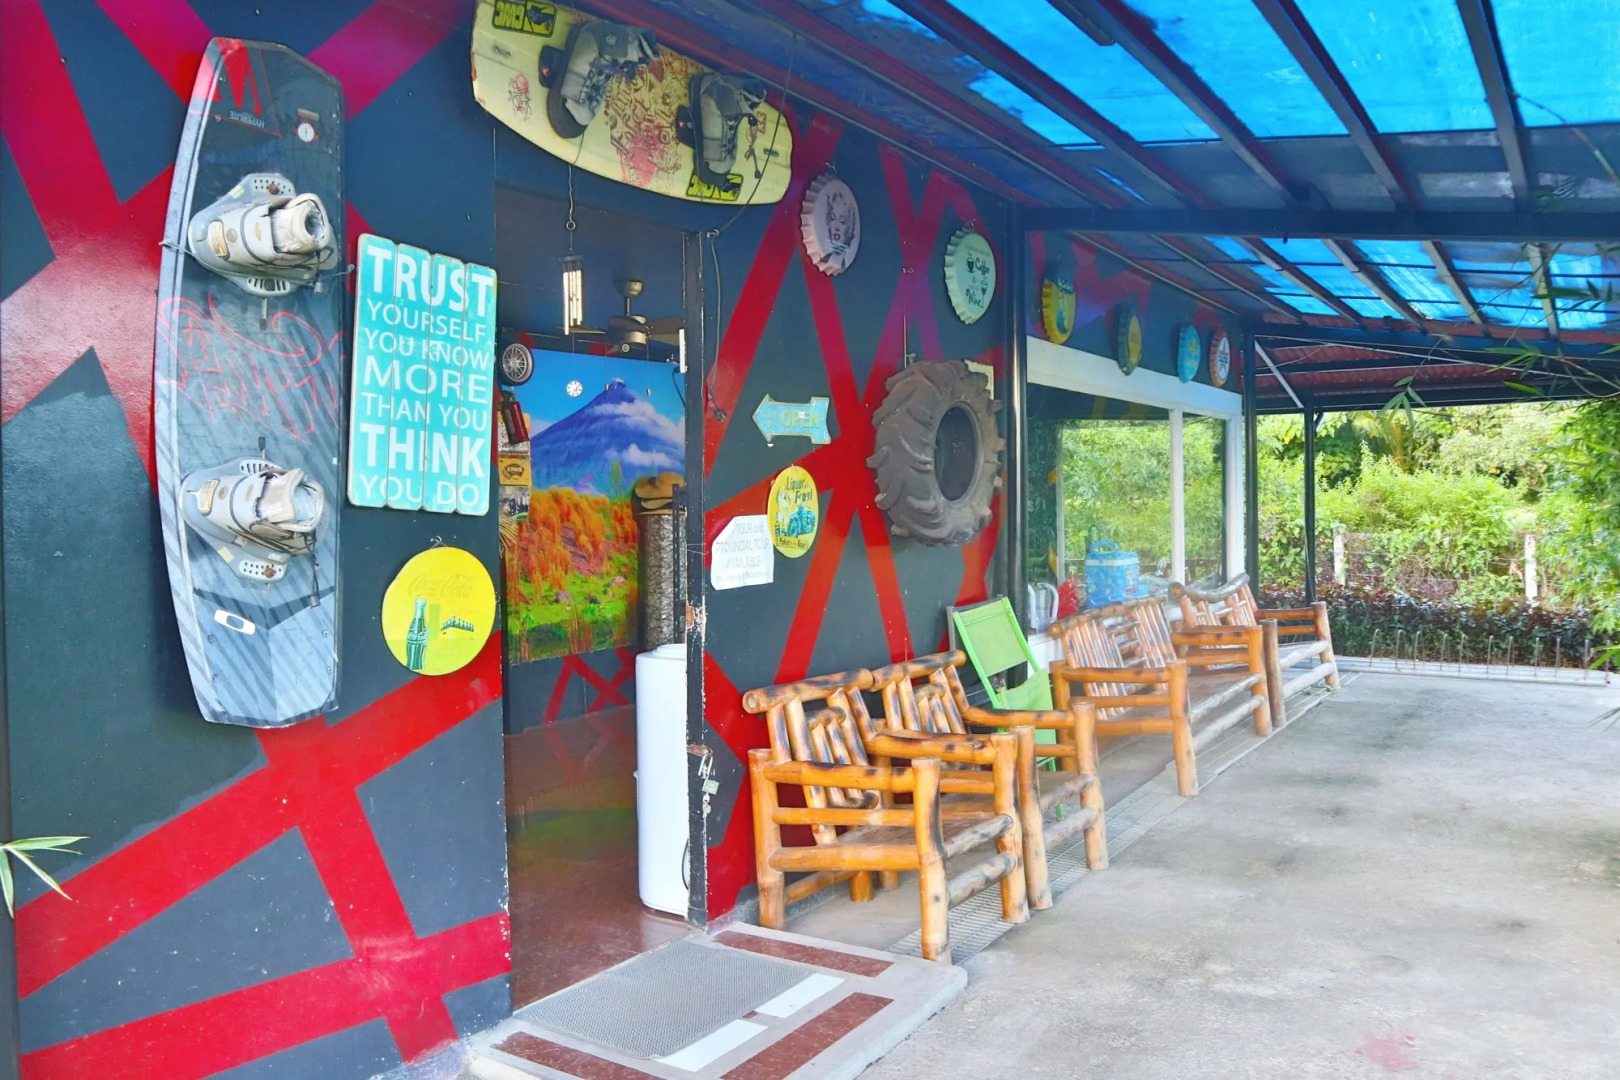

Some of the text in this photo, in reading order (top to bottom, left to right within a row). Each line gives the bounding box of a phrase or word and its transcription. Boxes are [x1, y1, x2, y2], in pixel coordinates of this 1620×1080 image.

[366, 245, 494, 318] TRUST
[364, 327, 490, 370] YOU KNOW
[363, 355, 488, 404] MORE
[361, 391, 488, 432] THAN YOU
[781, 410, 820, 429] OPEN
[360, 423, 485, 478] THINK
[359, 473, 480, 506] YOU DO
